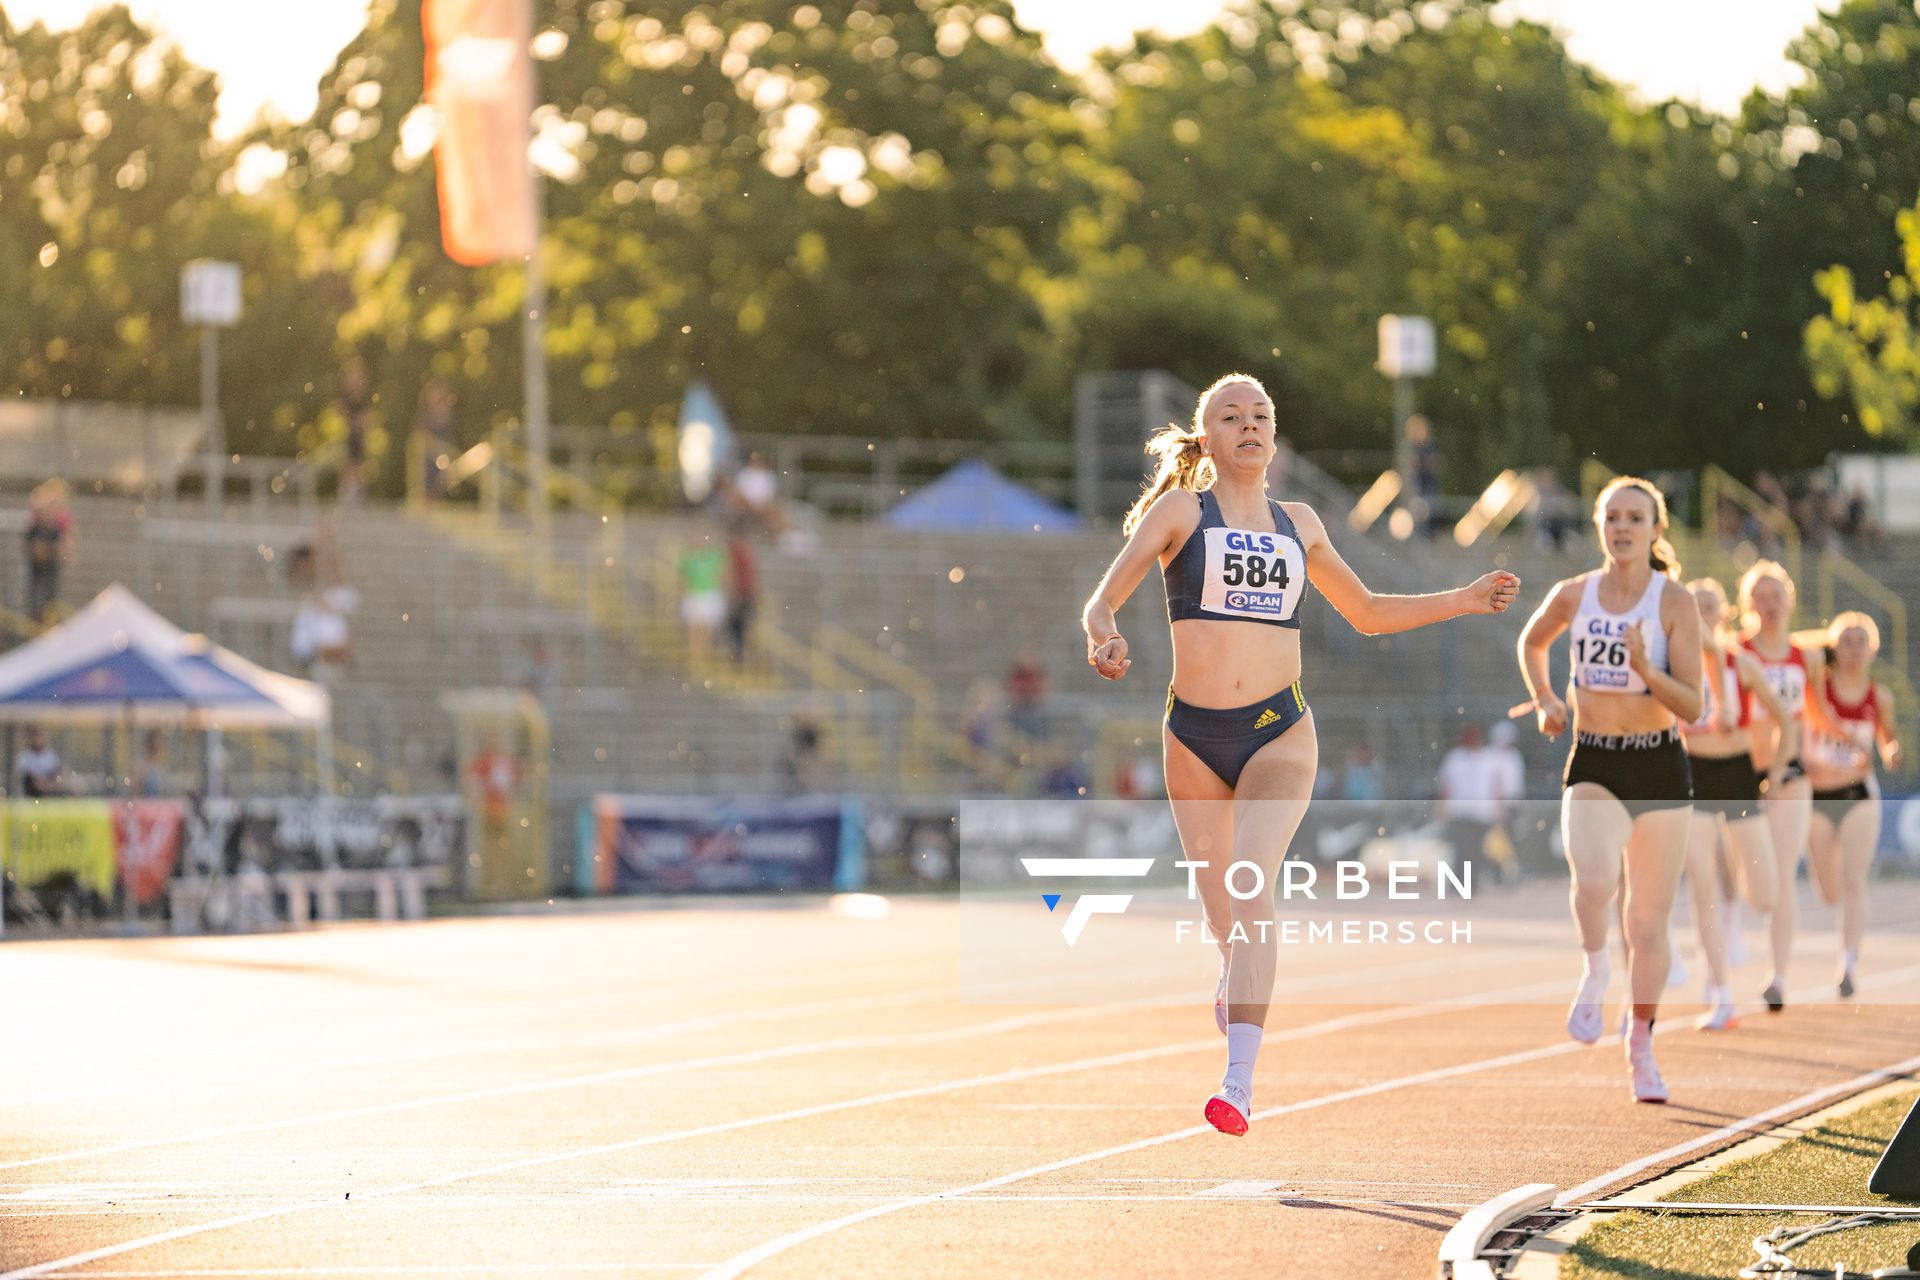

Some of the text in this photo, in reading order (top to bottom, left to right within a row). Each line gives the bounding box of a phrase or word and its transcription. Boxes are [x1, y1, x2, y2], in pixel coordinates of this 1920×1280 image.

[1223, 553, 1289, 589] 584
[1249, 595, 1280, 606] PLAN
[1254, 714, 1281, 729] adidas
[1621, 731, 1662, 751] PRO
